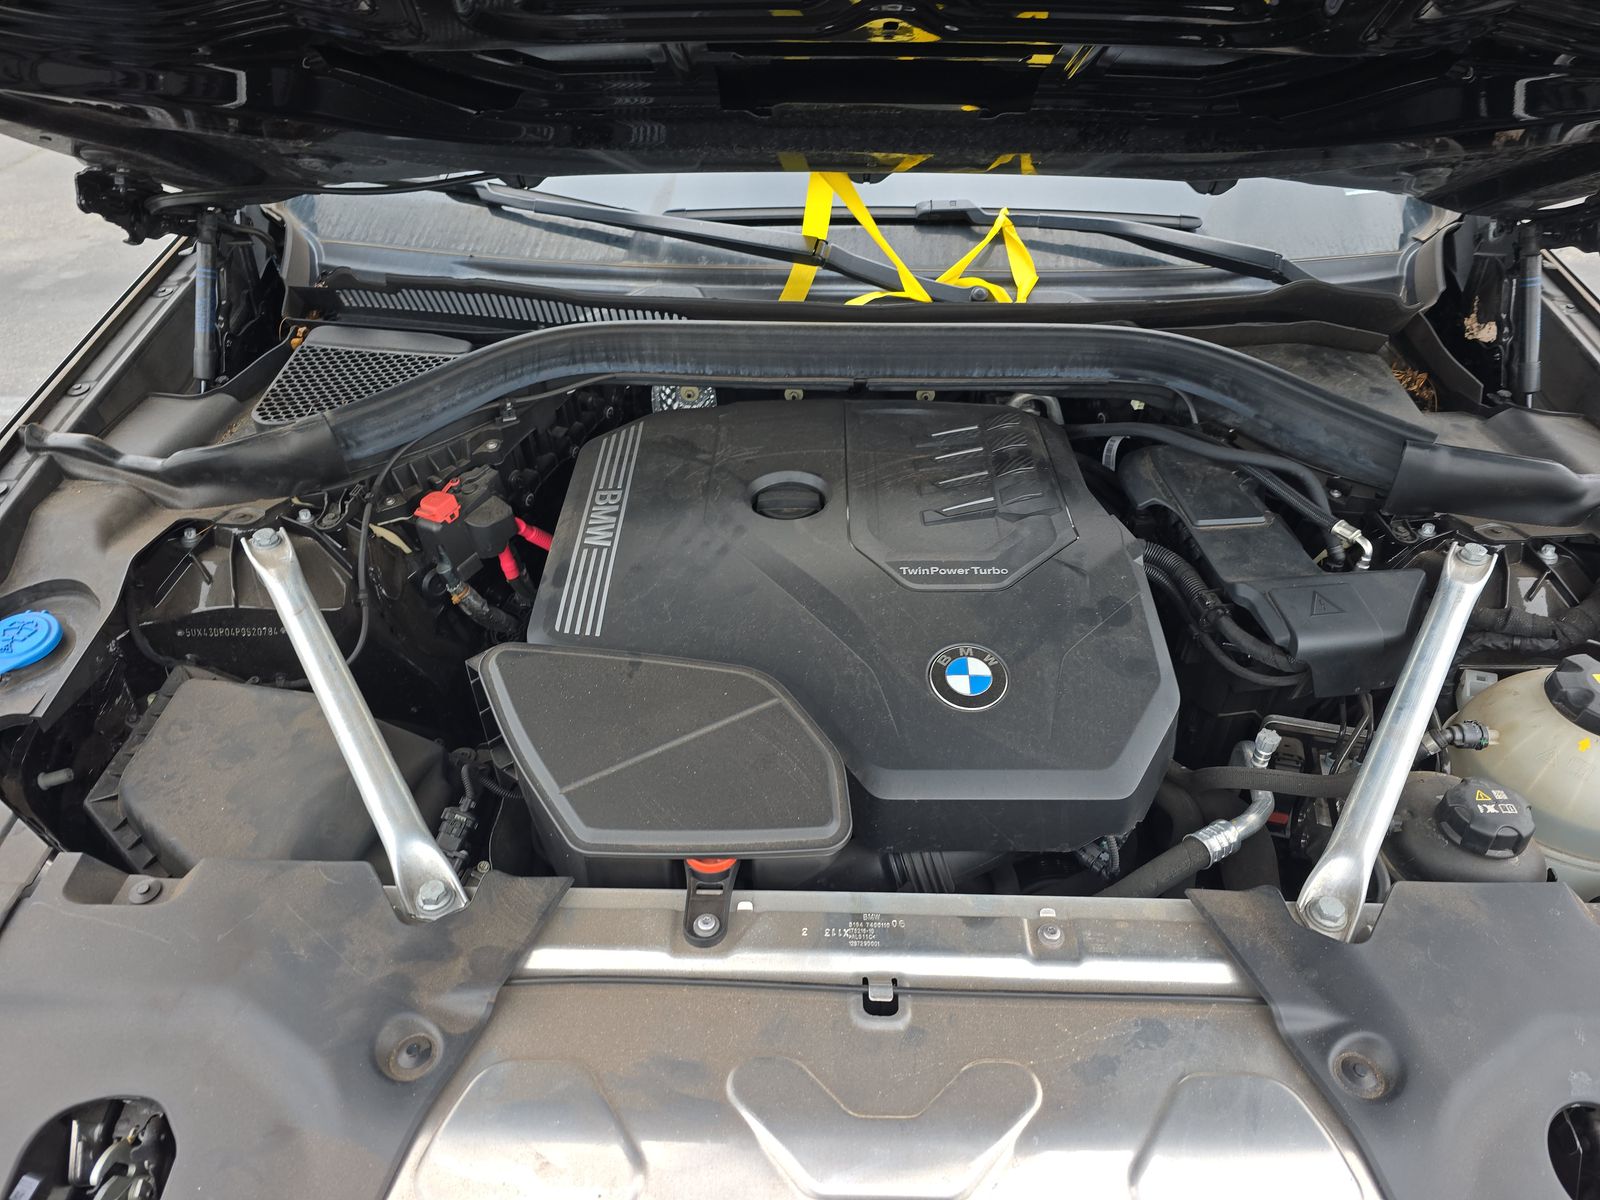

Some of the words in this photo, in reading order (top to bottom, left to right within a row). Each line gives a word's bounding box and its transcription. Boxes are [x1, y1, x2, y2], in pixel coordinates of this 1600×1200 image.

[583, 489, 623, 547] BMW
[900, 566, 970, 575] TwinPower
[971, 566, 1009, 575] Turbo
[937, 647, 998, 667] BMW
